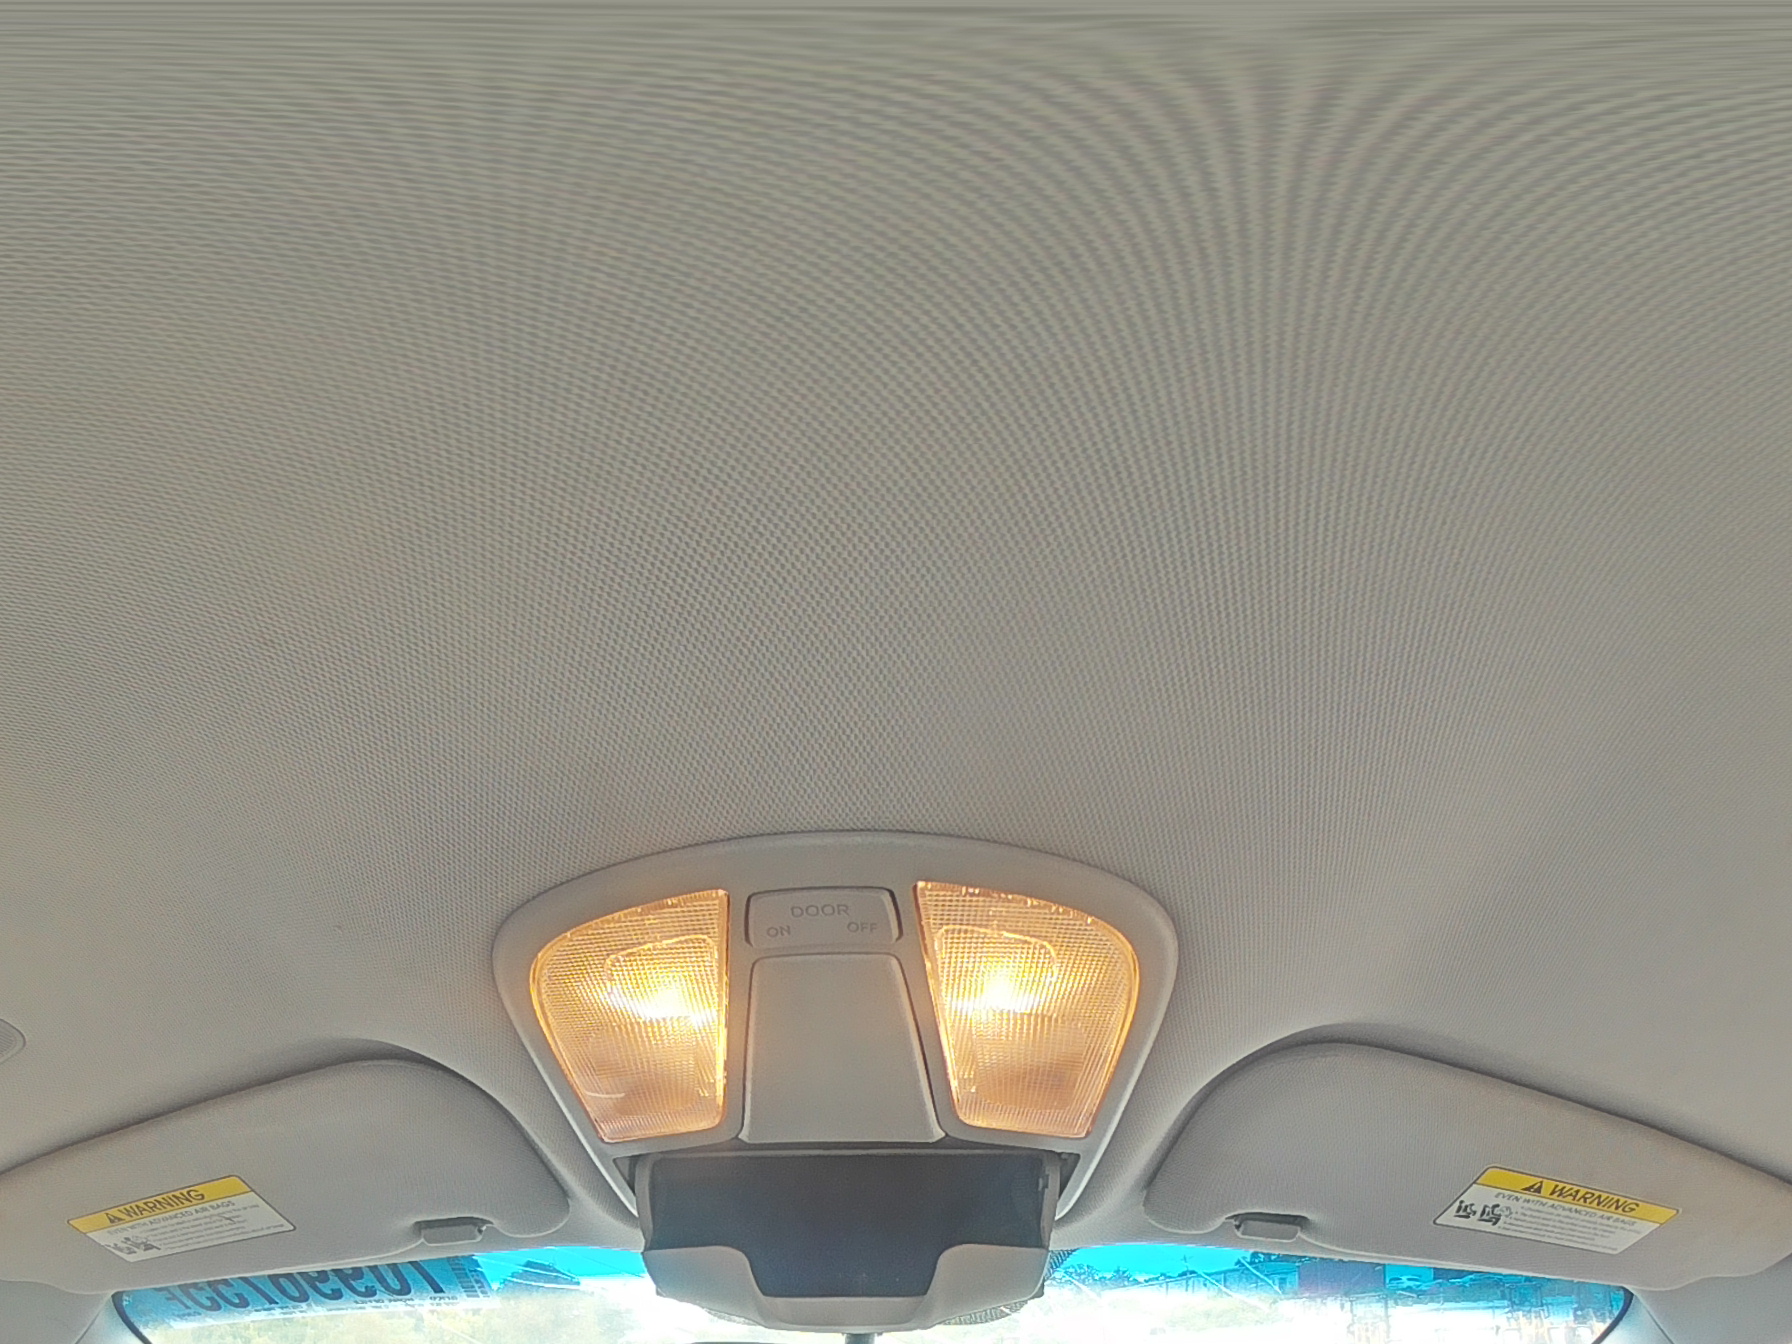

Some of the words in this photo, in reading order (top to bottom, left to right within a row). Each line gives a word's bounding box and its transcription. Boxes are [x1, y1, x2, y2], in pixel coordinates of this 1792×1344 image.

[790, 904, 851, 918] DOOR
[766, 925, 792, 938] ON
[846, 921, 878, 933] OFF
[117, 1188, 206, 1219] WARNING
[1494, 1191, 1521, 1203] EVEN
[1523, 1196, 1547, 1208] WITH
[1548, 1202, 1597, 1219] ADVANCED
[1598, 1212, 1614, 1222] AIR
[1613, 1215, 1638, 1228] BAGS
[1549, 1183, 1640, 1214] WARNING
[148, 1210, 194, 1228] ADVANCED
[194, 1206, 210, 1217] AIR
[210, 1200, 236, 1213] BAGS
